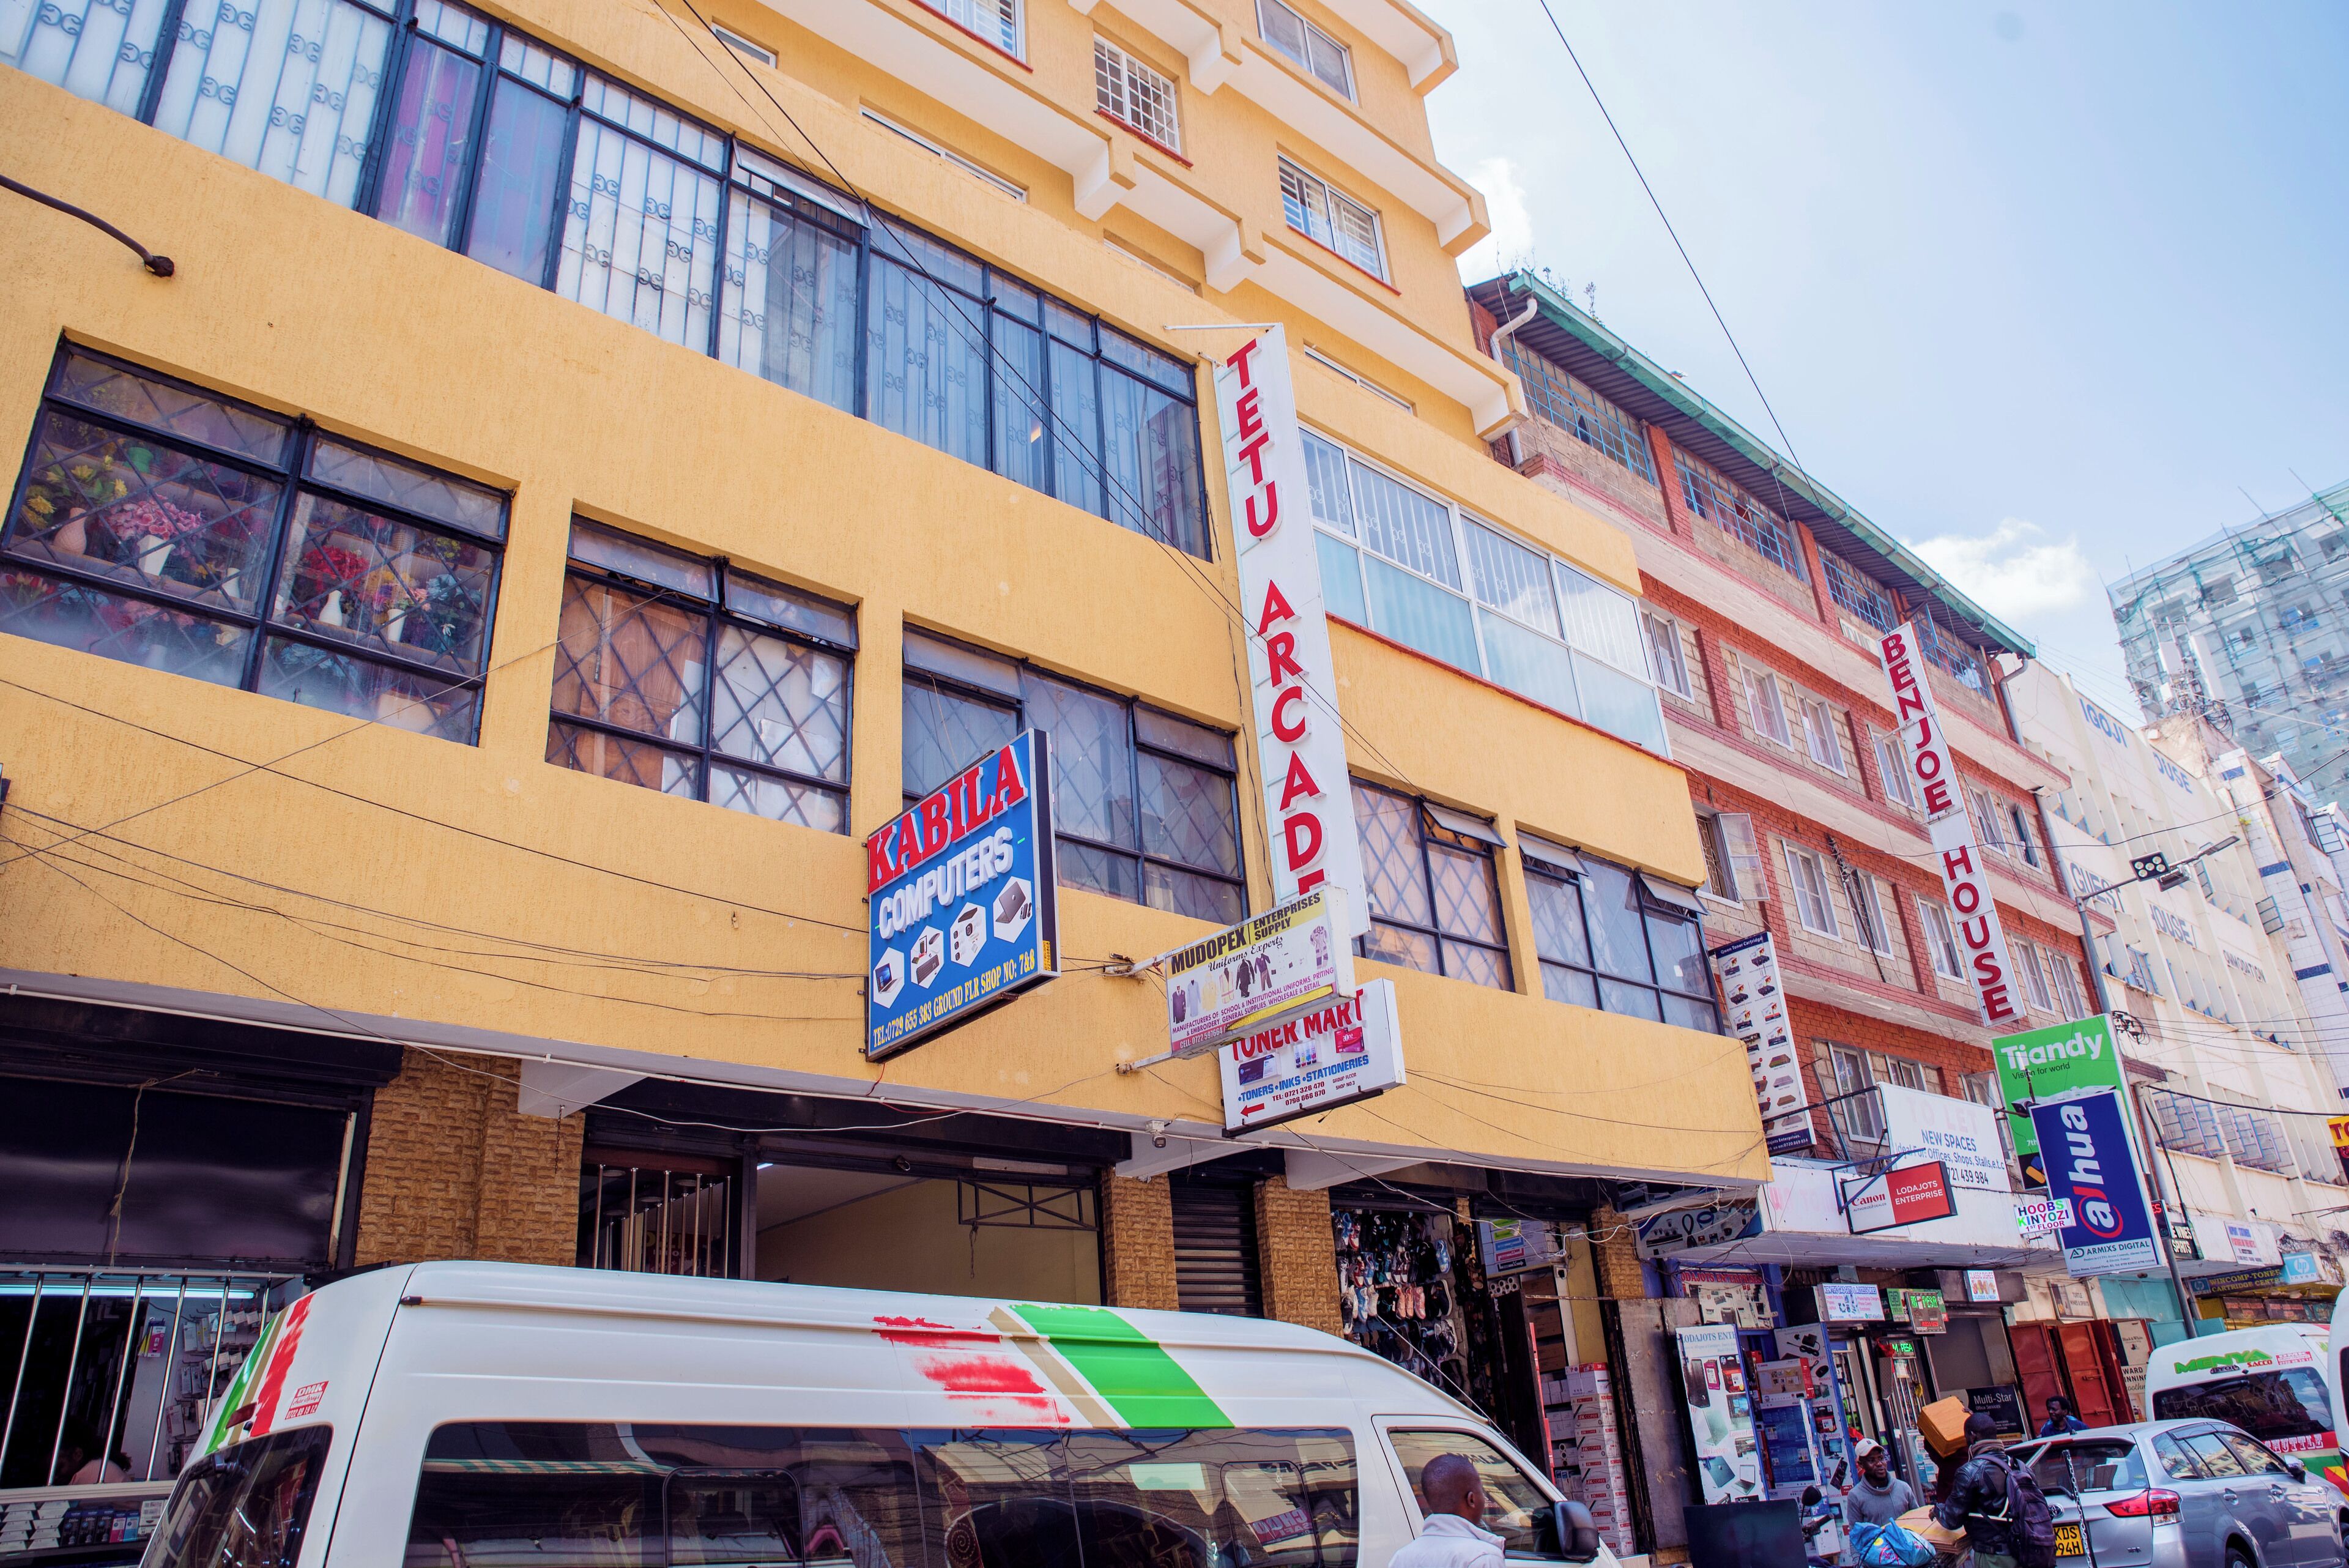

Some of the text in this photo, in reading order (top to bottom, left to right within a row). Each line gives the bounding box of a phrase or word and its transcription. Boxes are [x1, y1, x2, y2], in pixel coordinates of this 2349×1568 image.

[1226, 338, 1279, 538] TETU
[2079, 697, 2128, 748] IGOJI
[867, 745, 1028, 894] KABILA
[1881, 633, 2015, 1022] BENJOE HOUSE
[879, 826, 1014, 939] COMPUTERS
[2069, 862, 2125, 912] GUEST
[1171, 893, 1321, 975] MUDOPEX ENTERPRISES
[1255, 916, 1291, 940] SUPPLY
[1208, 936, 1283, 972] Uniforms Experts
[905, 1011, 917, 1031] 655
[919, 1003, 932, 1025] 383
[933, 993, 963, 1016] GROUND
[965, 983, 979, 1001] FLR
[981, 972, 1001, 994] SHOP
[1003, 962, 1017, 985] NO:
[1019, 953, 1035, 975] 7&8
[1173, 1015, 1211, 1034] MANUFACTURERS
[1221, 1004, 1241, 1016] SCHOOL
[1246, 987, 1282, 1006] INSTITUTIONAL
[1313, 967, 1334, 981] PRITING
[1222, 1011, 1244, 1022] GENERAL
[1269, 989, 1299, 1005] WHOLESALE
[1304, 981, 1321, 992] RETAIL
[1180, 1028, 1223, 1049] CELL: 0722 597664
[2000, 1032, 2102, 1071] Tiandy
[2038, 1066, 2047, 1075] for
[2049, 1062, 2070, 1072] world
[1272, 1081, 1325, 1102] TEL: 0721 328 470
[1285, 1089, 1326, 1106] 0798 868 870
[1921, 1129, 1976, 1151] NEW SPACES
[1947, 1167, 1989, 1184] 721 439 984
[1896, 1180, 1938, 1195] LODAJOTS
[1851, 1194, 1885, 1206] Canon
[1895, 1189, 1943, 1205] ENTERPRISE
[2018, 1200, 2065, 1216] HOOBS
[2017, 1209, 2069, 1227] KINYOZI
[2038, 1220, 2065, 1230] FLOOR
[2087, 1241, 2150, 1255] ARMIXS DIGITAL
[1682, 1271, 1714, 1282] ODAJOTS
[2212, 1281, 2253, 1293] CARTRIDGE
[1900, 1343, 1913, 1352] PESA
[2173, 1348, 2273, 1374] MENYA
[2247, 1359, 2273, 1368] SACCO
[297, 1382, 325, 1397] DMK
[1973, 1393, 2012, 1405] Multi-Star
[2054, 1526, 2077, 1541] KDS
[2055, 1540, 2081, 1555] 94H
